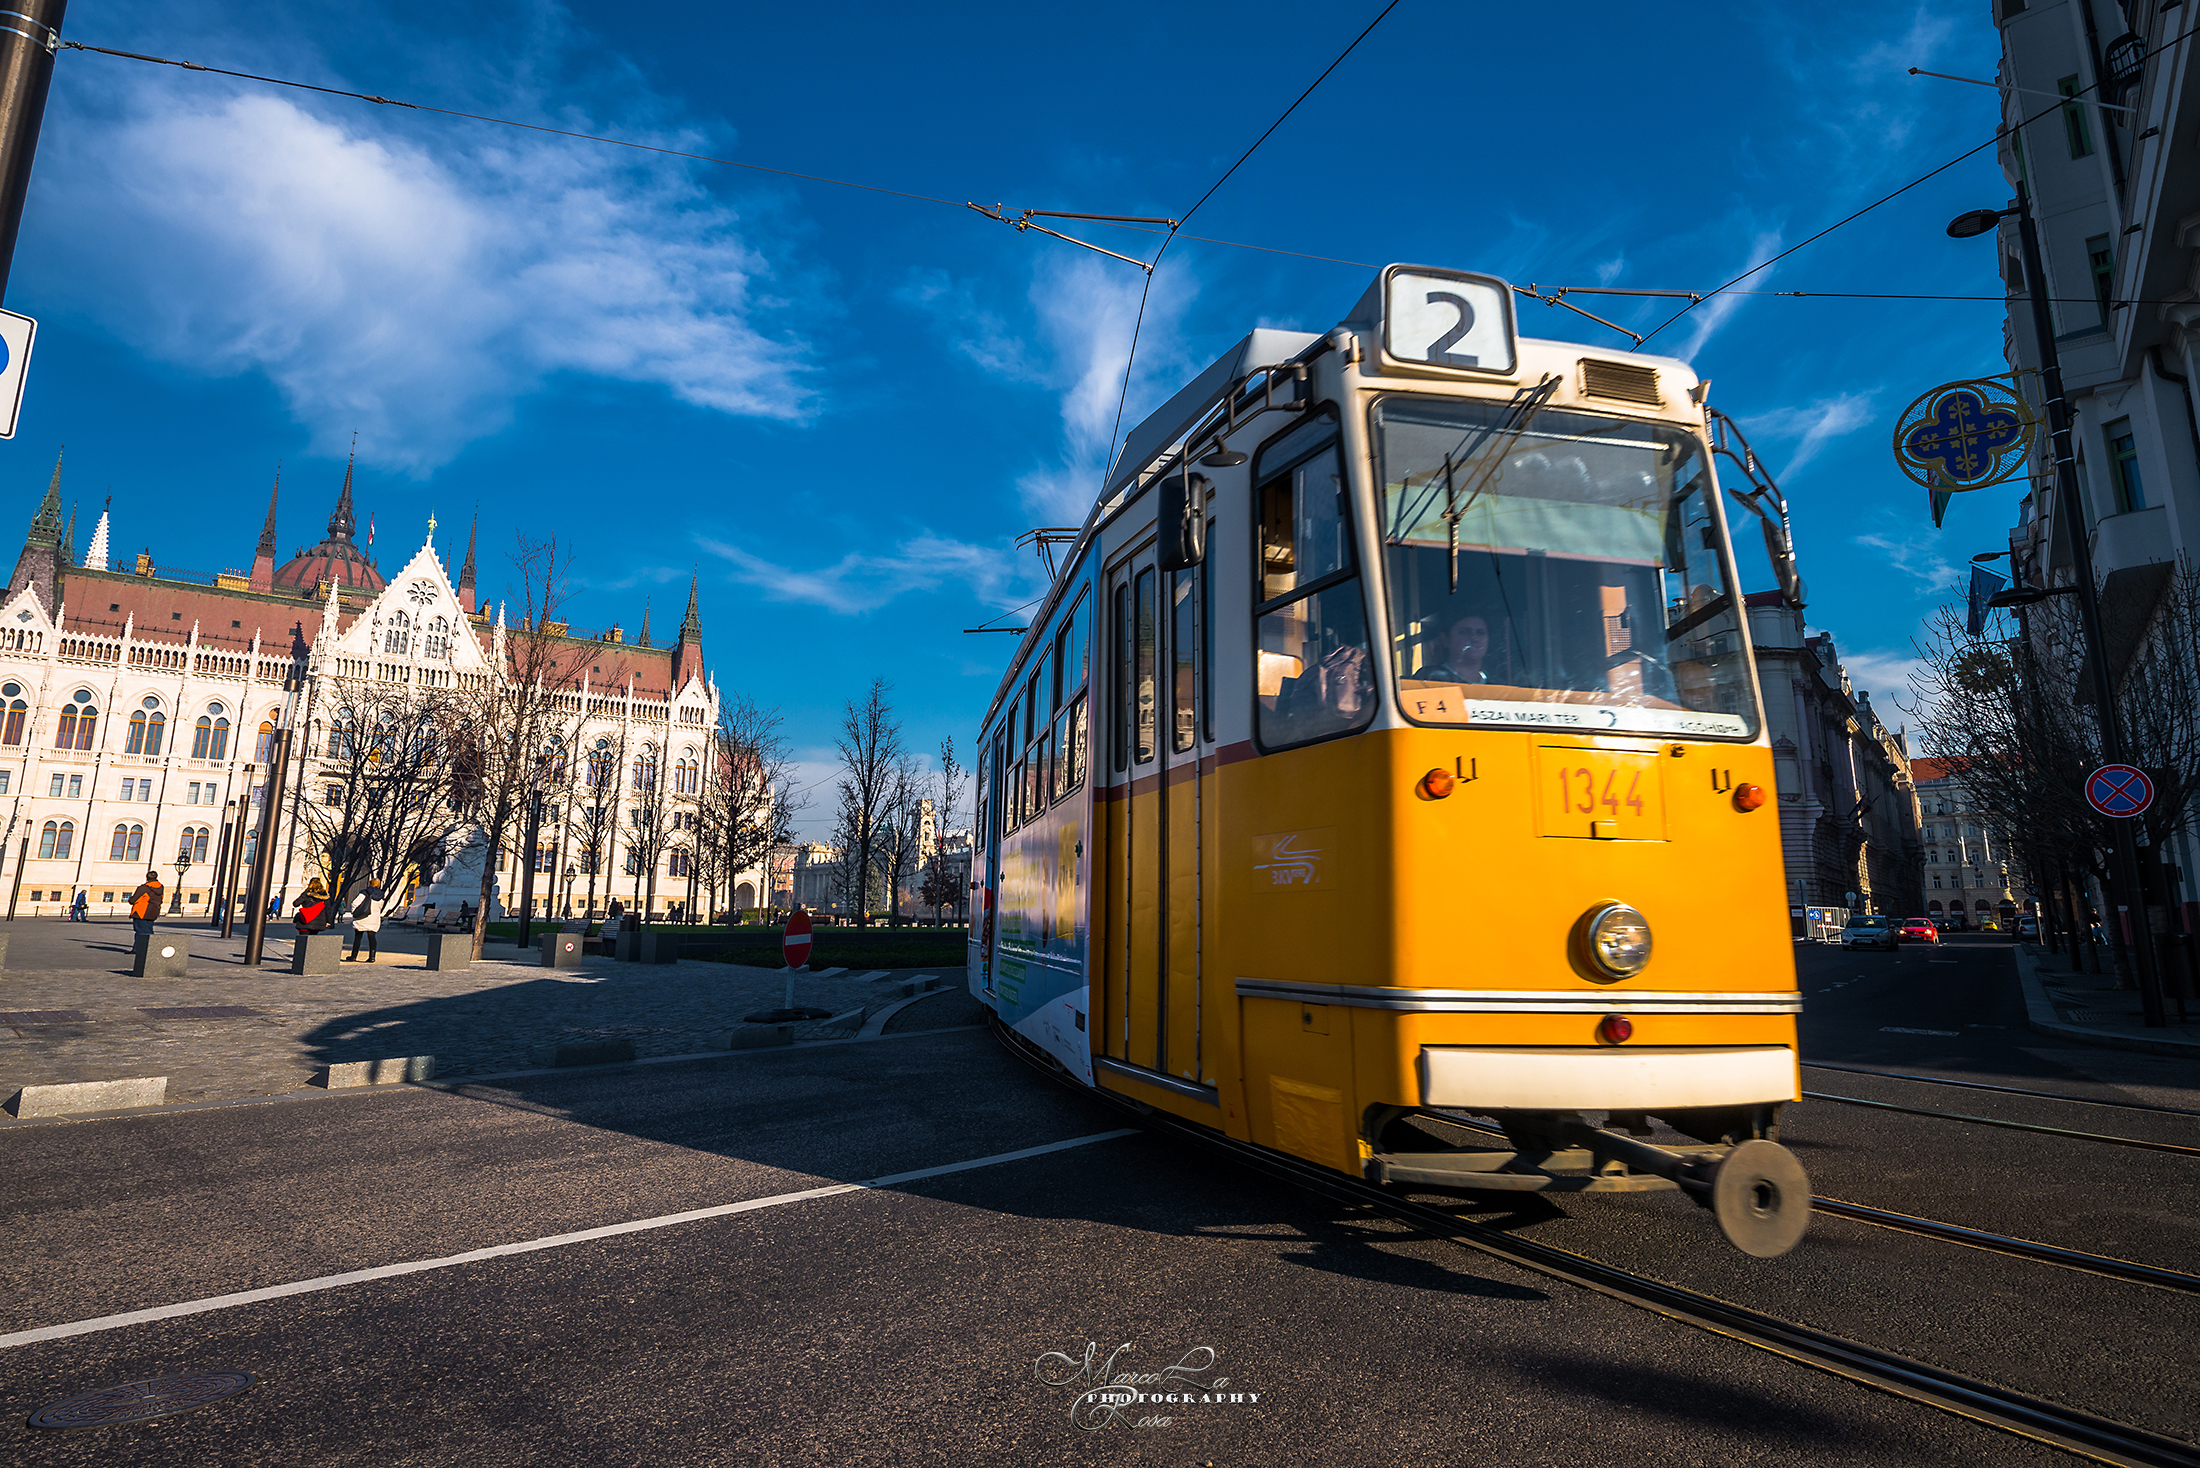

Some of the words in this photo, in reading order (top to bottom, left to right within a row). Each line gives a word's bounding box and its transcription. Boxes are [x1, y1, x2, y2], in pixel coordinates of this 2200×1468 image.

[1426, 291, 1479, 368] 2
[1415, 700, 1428, 715] F
[1436, 699, 1447, 714] 4
[1470, 707, 1511, 722] ÁSZAI
[1515, 711, 1552, 724] MARI
[1559, 766, 1644, 817] 1344
